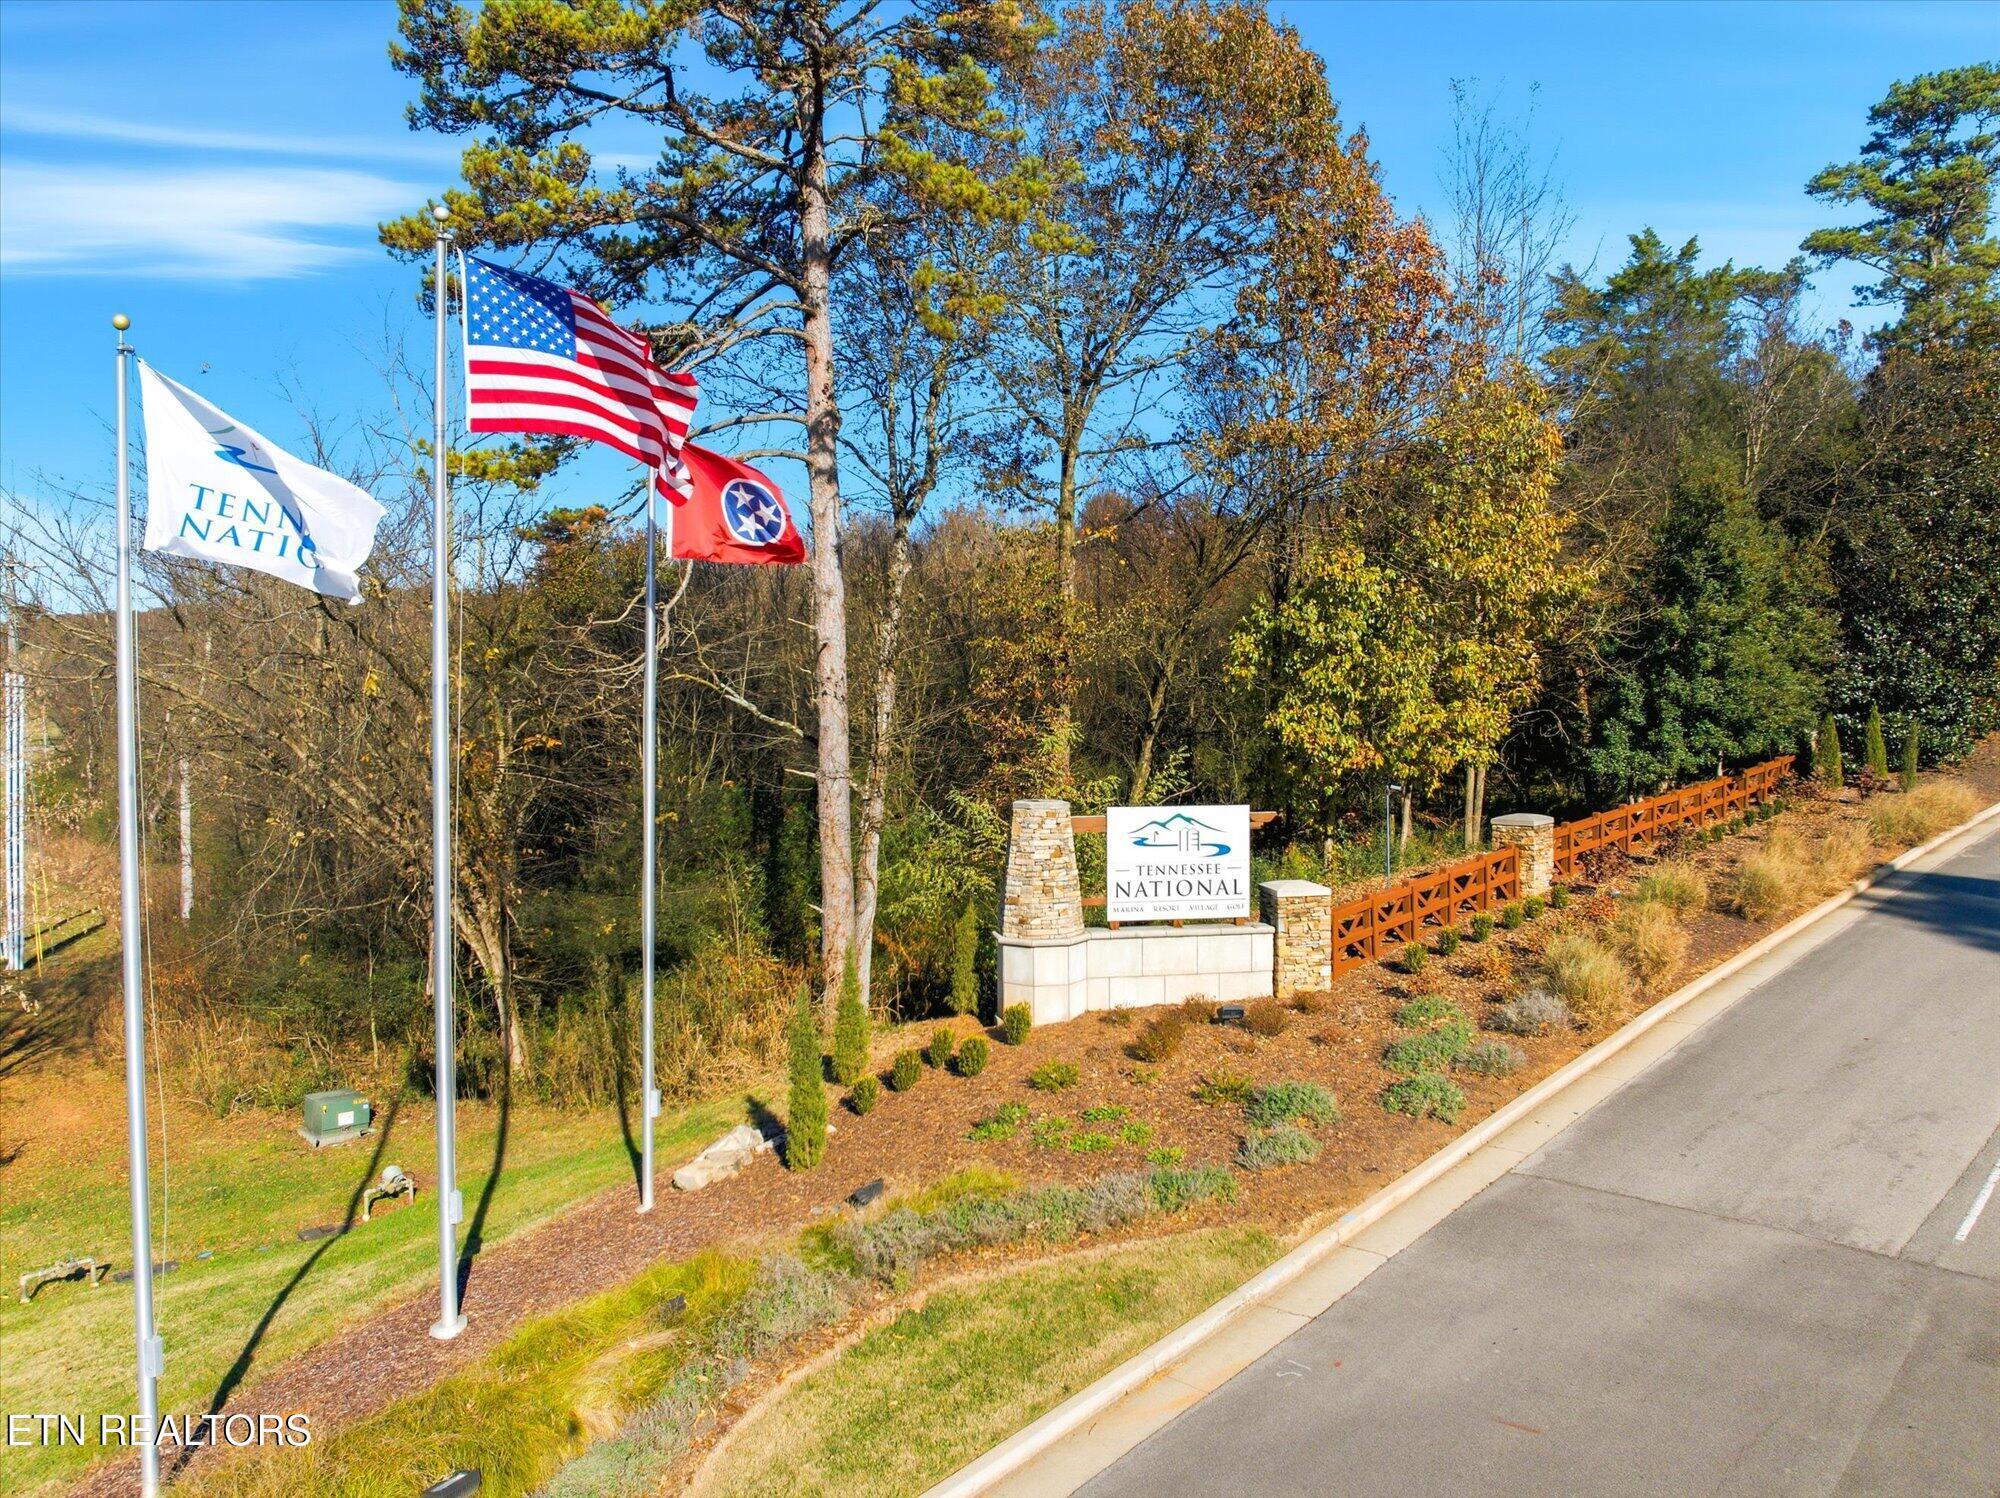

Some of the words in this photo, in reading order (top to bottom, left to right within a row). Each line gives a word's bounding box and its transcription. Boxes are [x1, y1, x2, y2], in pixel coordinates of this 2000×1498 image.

[1136, 863, 1221, 877] TENNESSEE
[1115, 878, 1243, 899] NATIONAL
[1153, 904, 1180, 912] RESORT
[1189, 903, 1219, 911] VILLAGE
